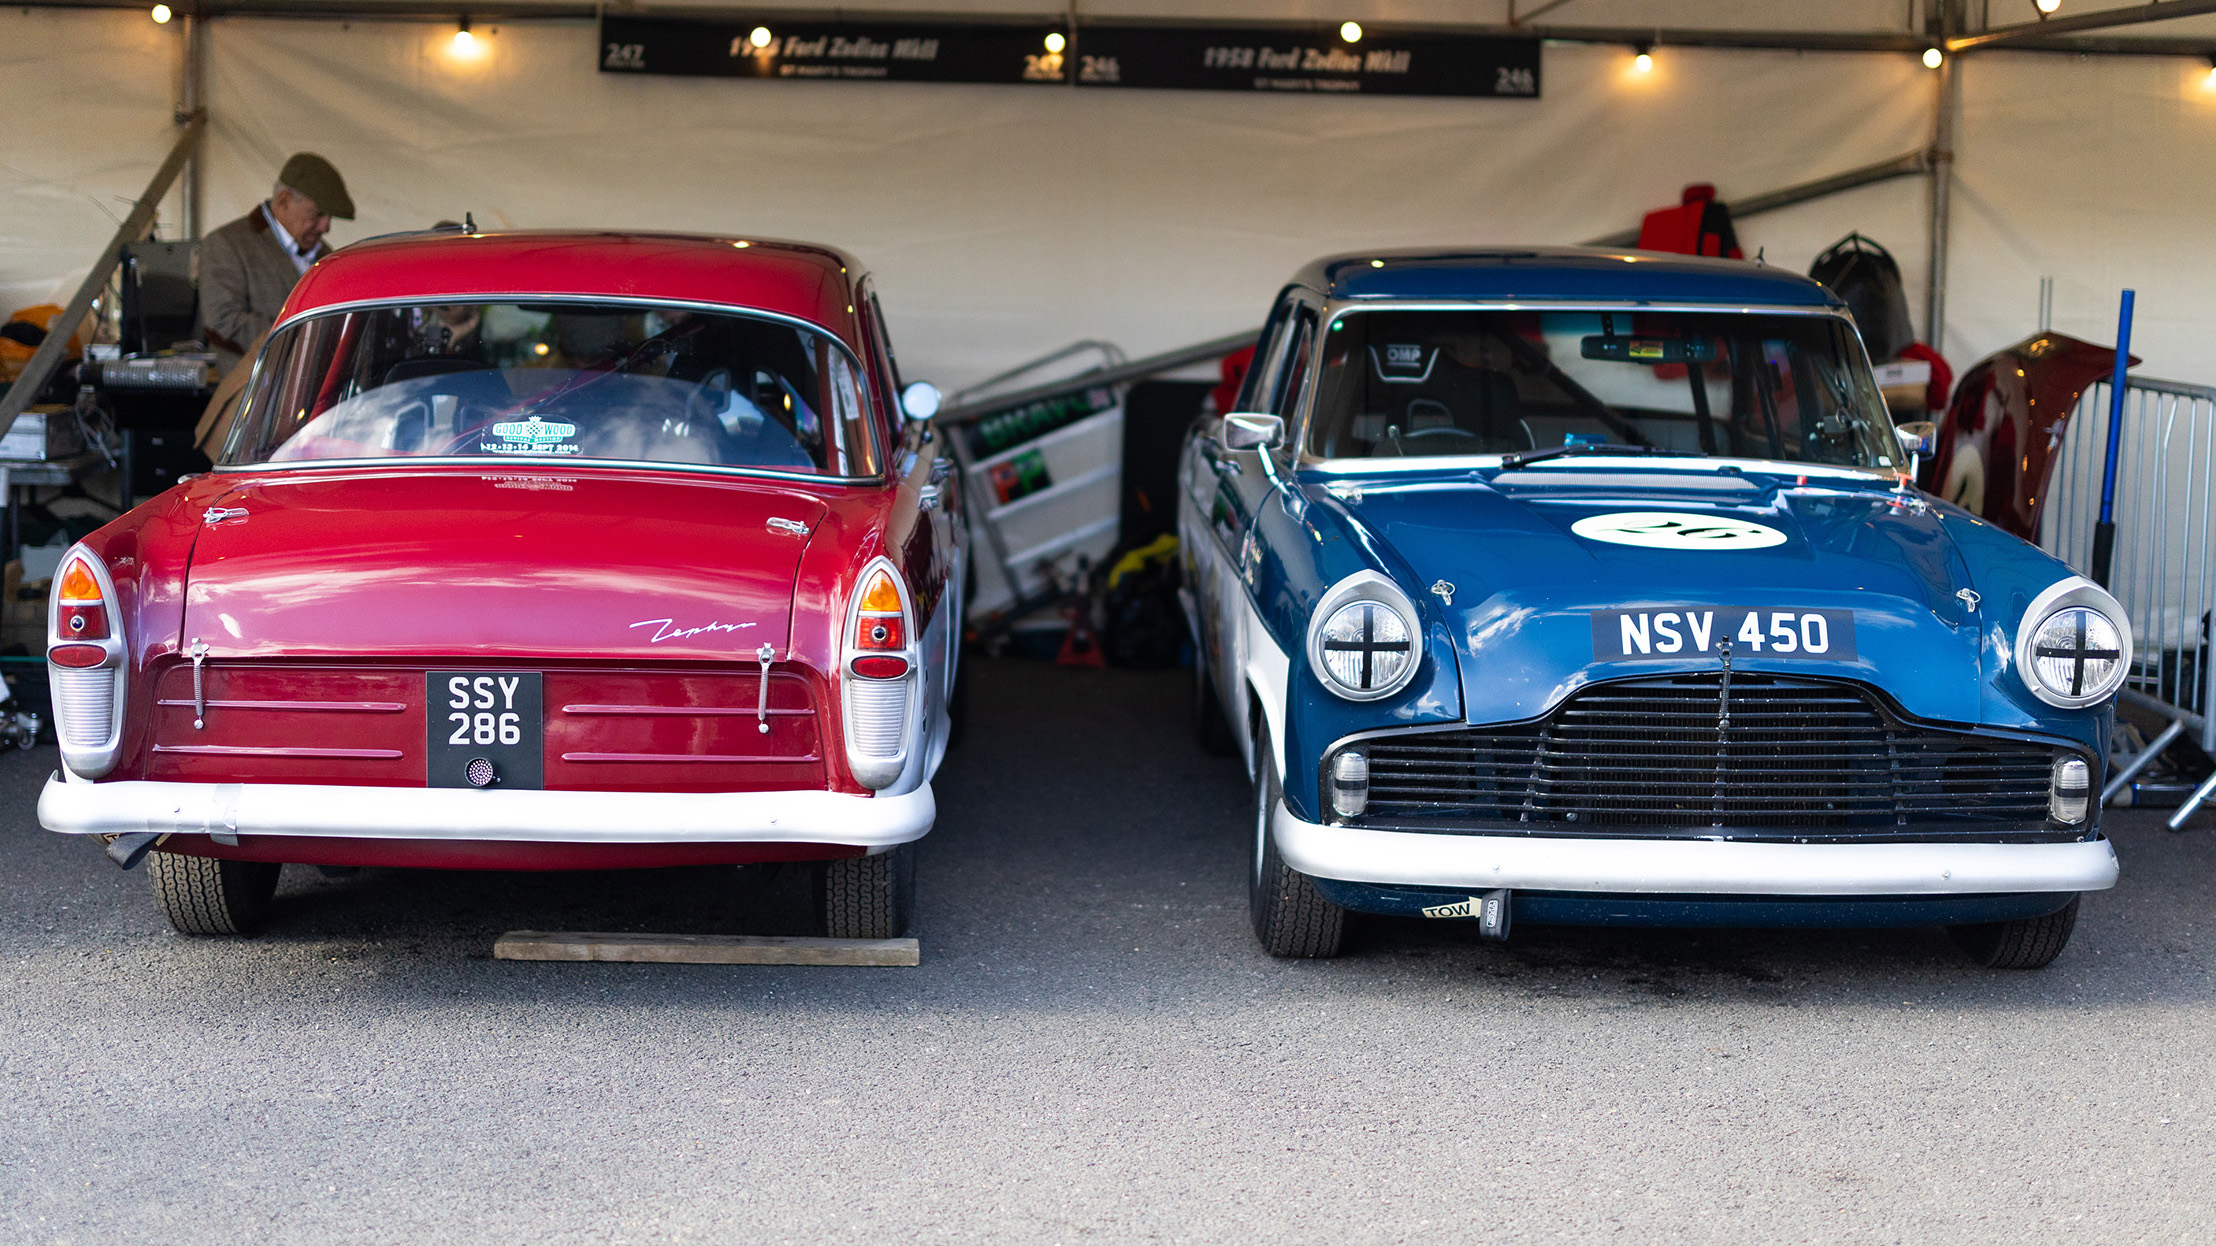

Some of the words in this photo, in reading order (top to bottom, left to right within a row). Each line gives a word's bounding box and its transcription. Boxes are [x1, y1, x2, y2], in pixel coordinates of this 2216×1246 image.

[606, 43, 644, 62] 247
[783, 35, 828, 57] Ford
[1203, 46, 1255, 68] 1958
[1256, 46, 1300, 69] Ford
[1301, 47, 1362, 72] Zodiac
[1387, 348, 1421, 362] OMP
[495, 424, 523, 435] GOOD
[544, 424, 573, 436] WOOD
[629, 618, 757, 643] Zephyr
[1620, 611, 1714, 655] NSV
[1737, 611, 1829, 654] 450
[448, 676, 520, 710] SSY
[448, 712, 521, 745] 286
[1425, 903, 1470, 917] TOW
